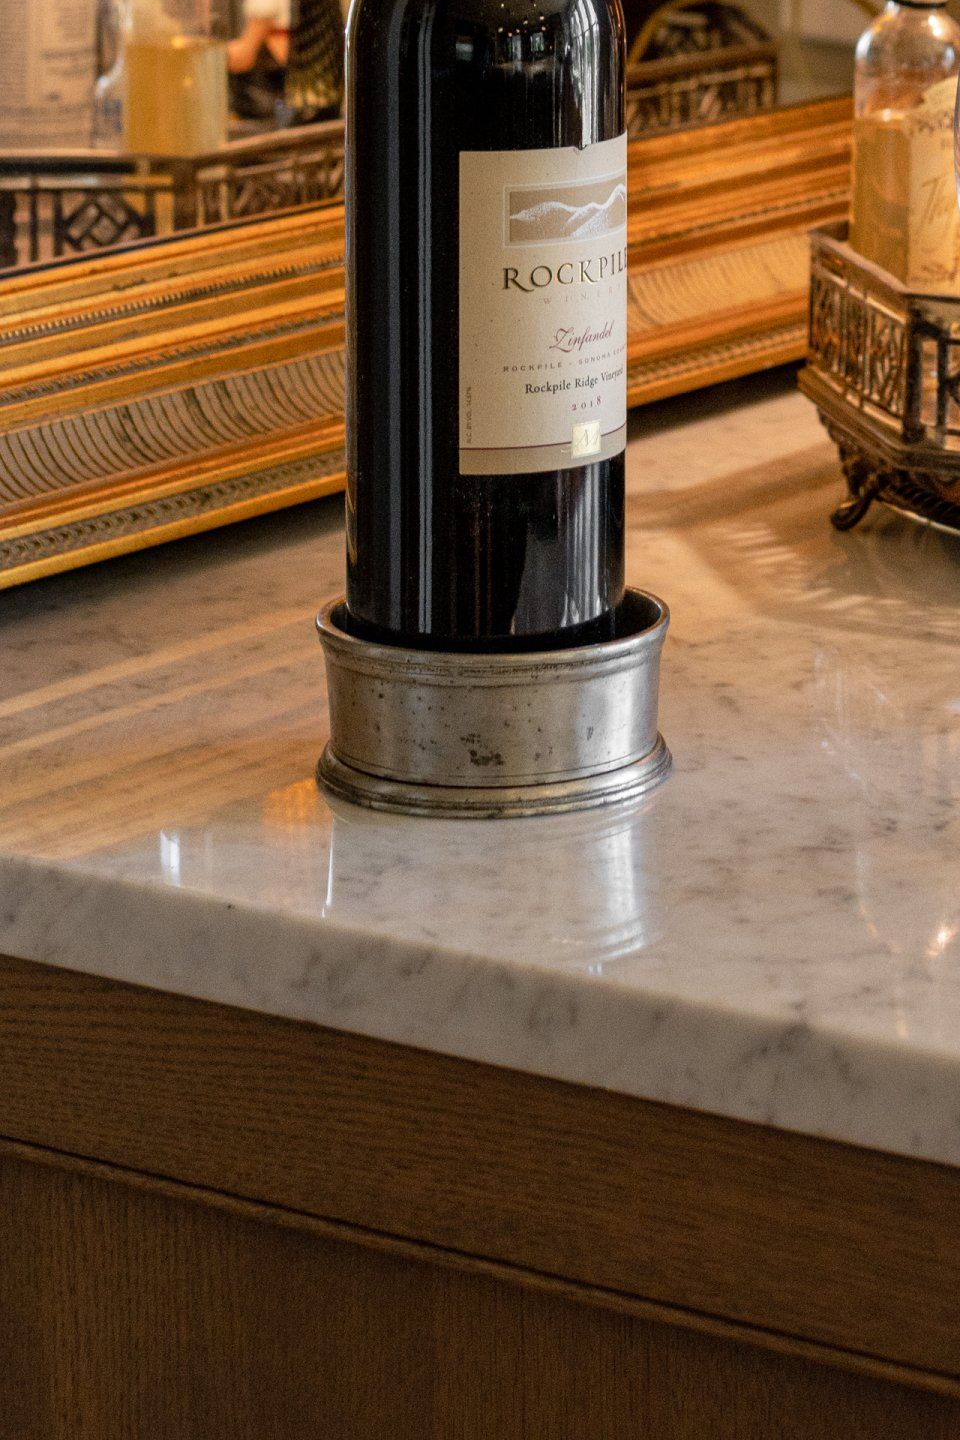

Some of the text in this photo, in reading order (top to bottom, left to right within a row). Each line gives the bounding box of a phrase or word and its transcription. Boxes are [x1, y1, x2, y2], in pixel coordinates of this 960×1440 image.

[549, 319, 615, 353] Zinfandel
[503, 361, 563, 373] ROCKPILE
[578, 352, 611, 366] SONOMA
[525, 378, 571, 395] Rockpile
[575, 375, 599, 389] Ridge
[571, 395, 602, 412] 2018
